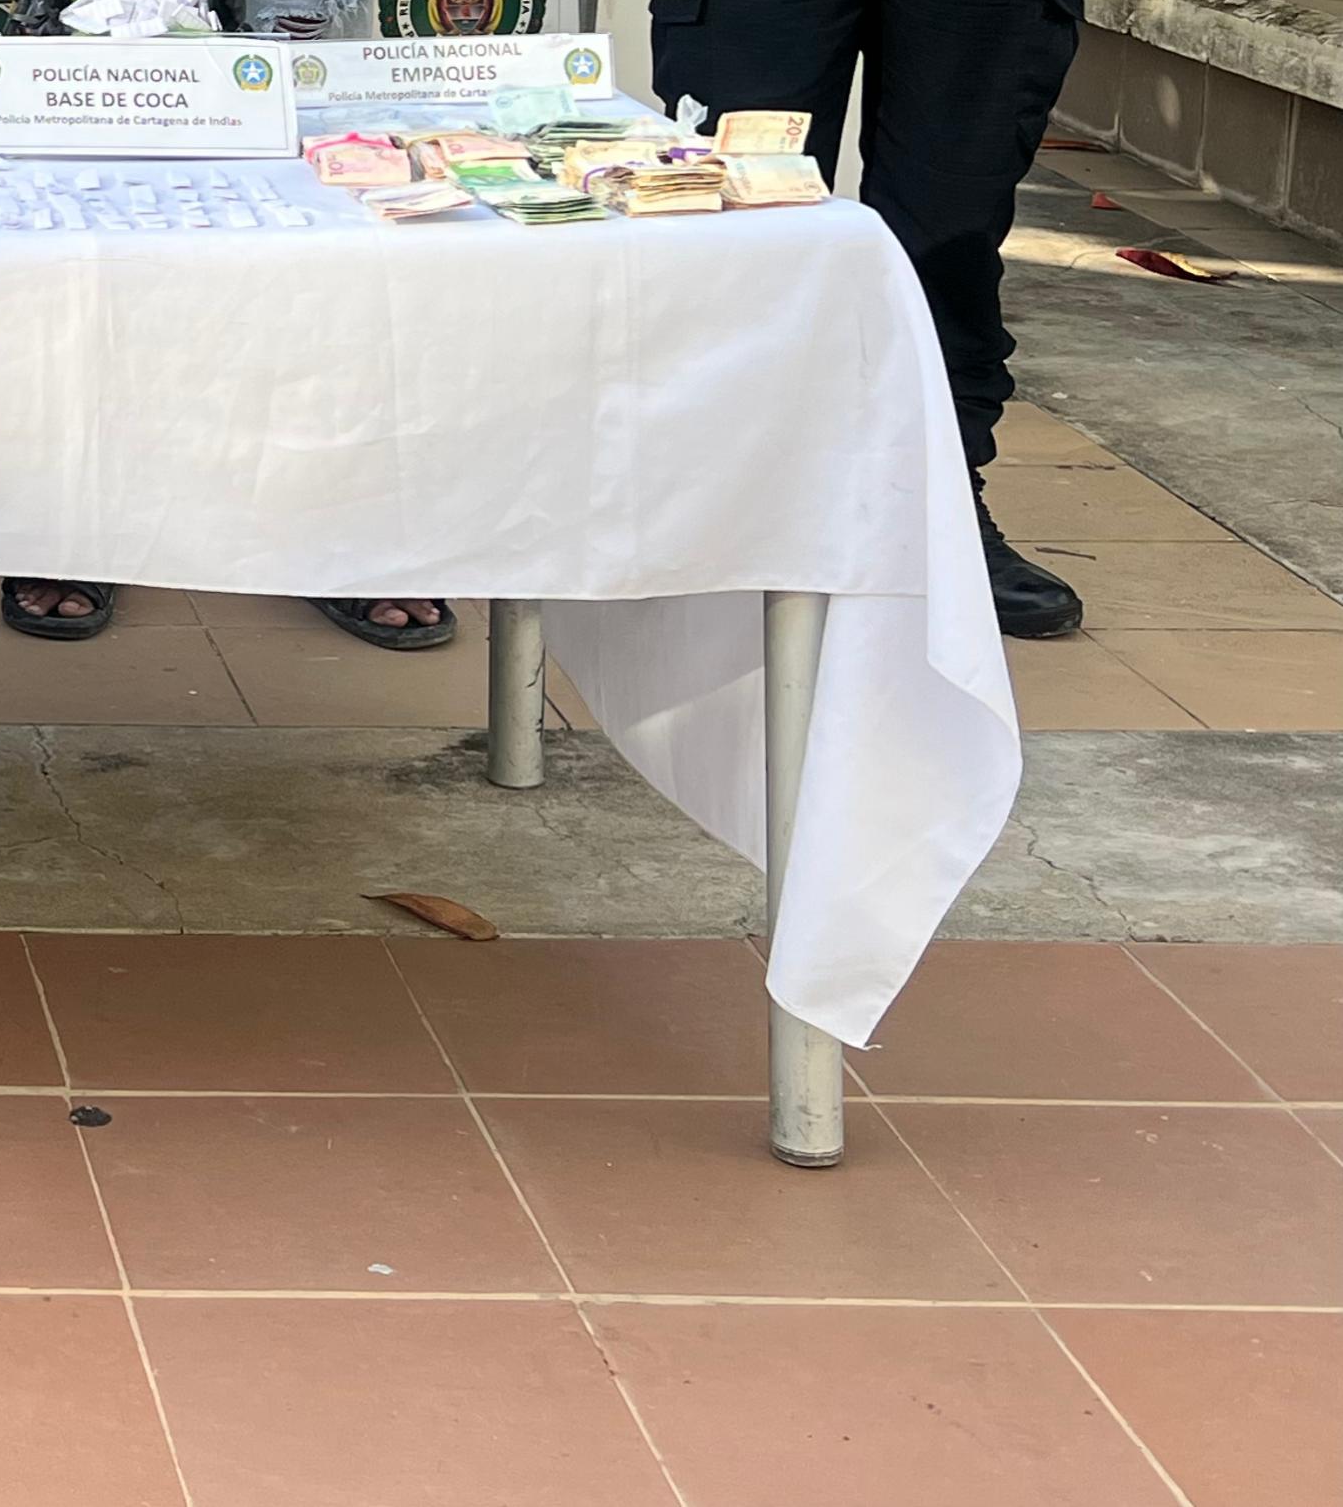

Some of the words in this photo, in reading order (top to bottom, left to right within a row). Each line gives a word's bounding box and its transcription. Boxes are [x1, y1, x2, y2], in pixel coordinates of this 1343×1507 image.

[362, 42, 429, 61] POLICÍA
[433, 42, 523, 60] NACIONAL
[32, 64, 100, 83] POLICÍA
[106, 67, 201, 83] NACIONAL
[391, 65, 498, 83] EMPAQUES
[46, 91, 96, 108] BASE
[102, 91, 127, 108] DE
[133, 92, 189, 109] COCA
[328, 91, 363, 102] Policía
[365, 89, 442, 102] Metropolitana
[443, 88, 457, 98] de
[459, 87, 490, 98] Carta
[34, 114, 114, 128] Metropolitana
[116, 114, 130, 125] de
[133, 115, 190, 129] Cartagena
[192, 115, 207, 126] de
[209, 115, 243, 127] Indias
[785, 116, 805, 136] 20
